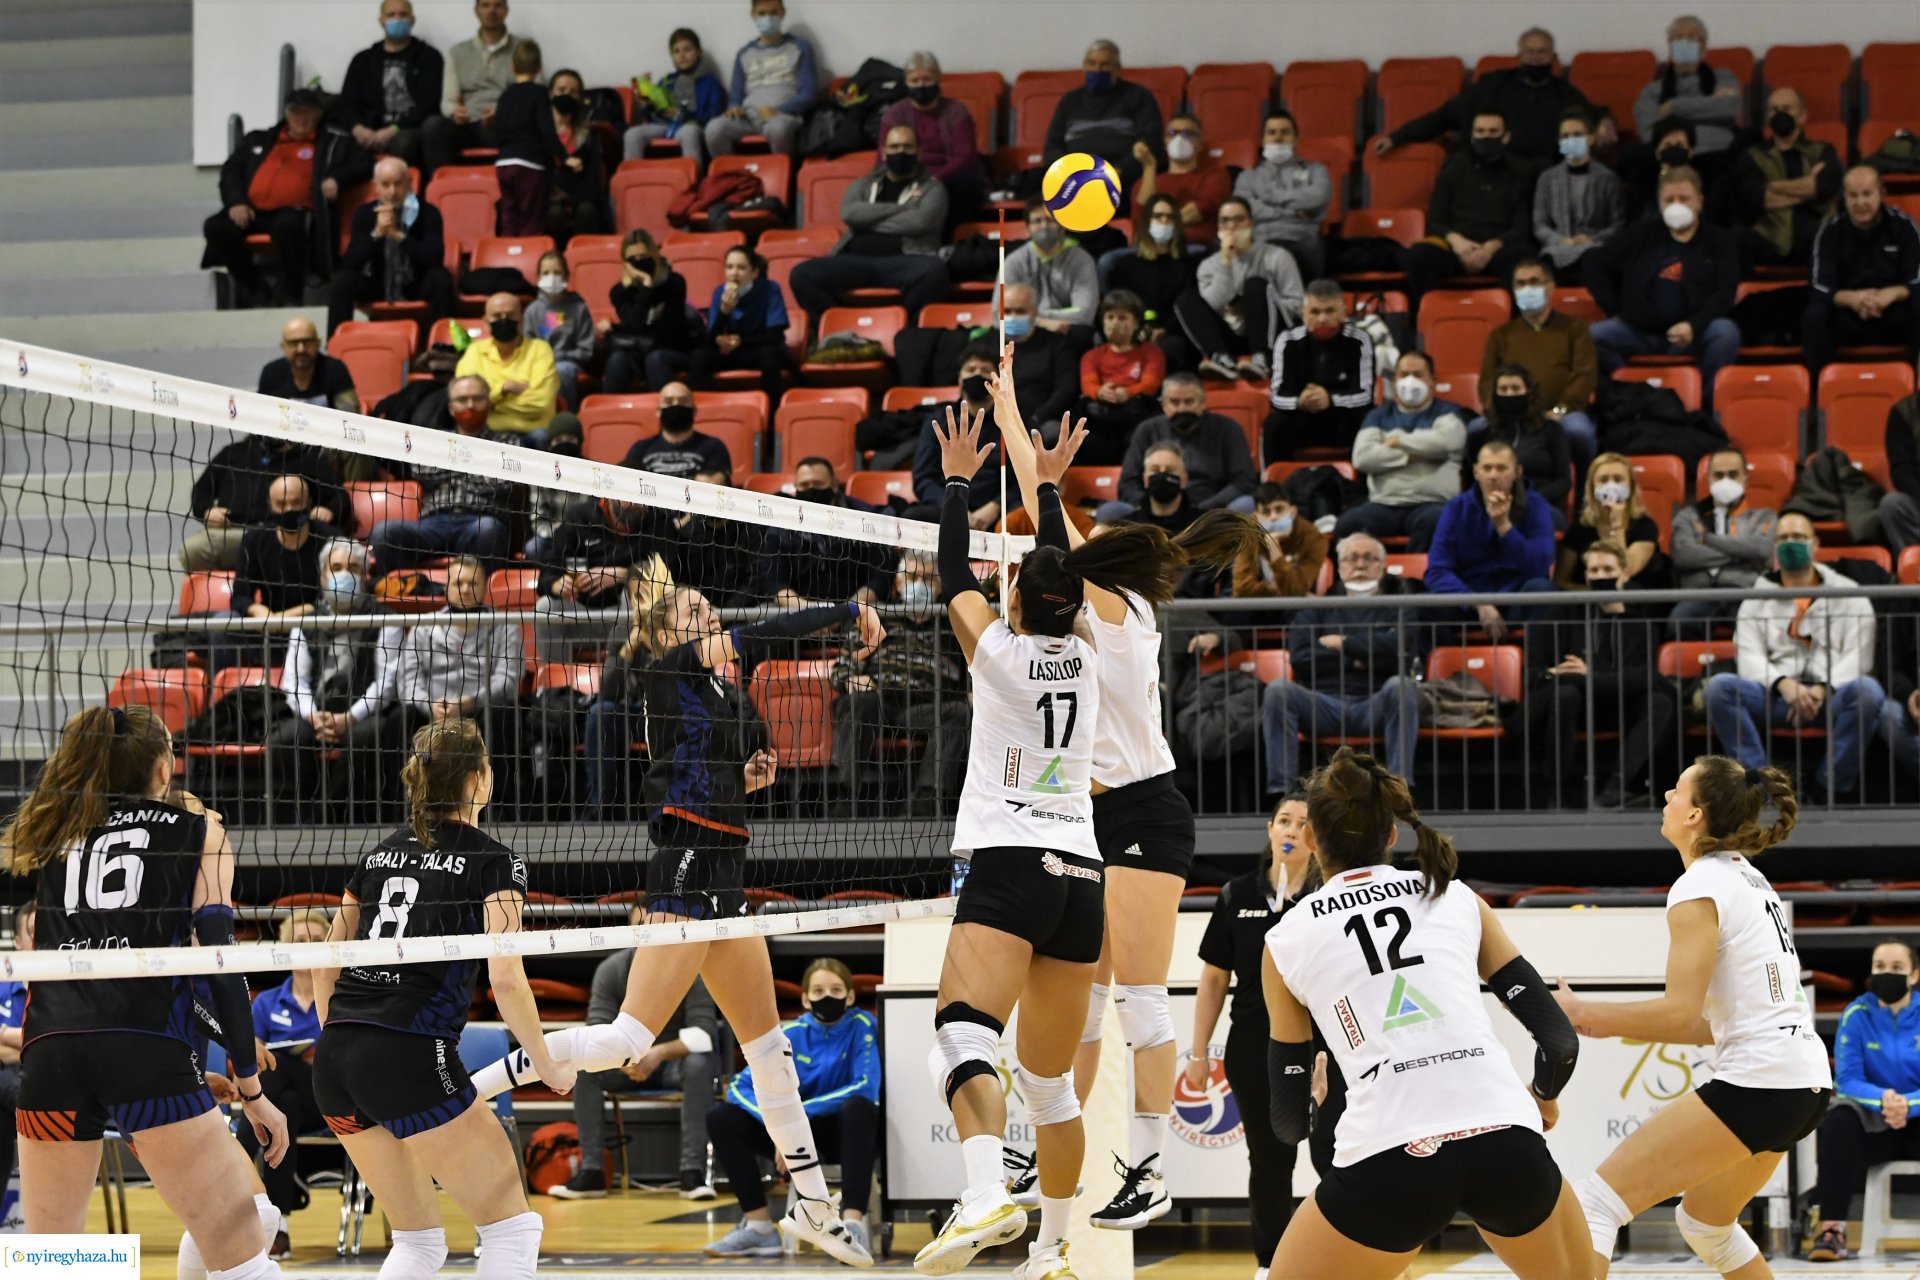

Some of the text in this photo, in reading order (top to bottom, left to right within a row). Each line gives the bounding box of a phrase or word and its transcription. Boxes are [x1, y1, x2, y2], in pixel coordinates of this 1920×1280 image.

[1036, 691, 1078, 749] 17
[1007, 747, 1018, 788] STRABAG
[1031, 808, 1086, 824] BESTRONG
[64, 827, 150, 917] 16
[368, 876, 420, 941] 8
[1343, 906, 1425, 976] 12
[1337, 999, 1362, 1048] STRABAG
[1394, 1047, 1485, 1073] BESTRONG
